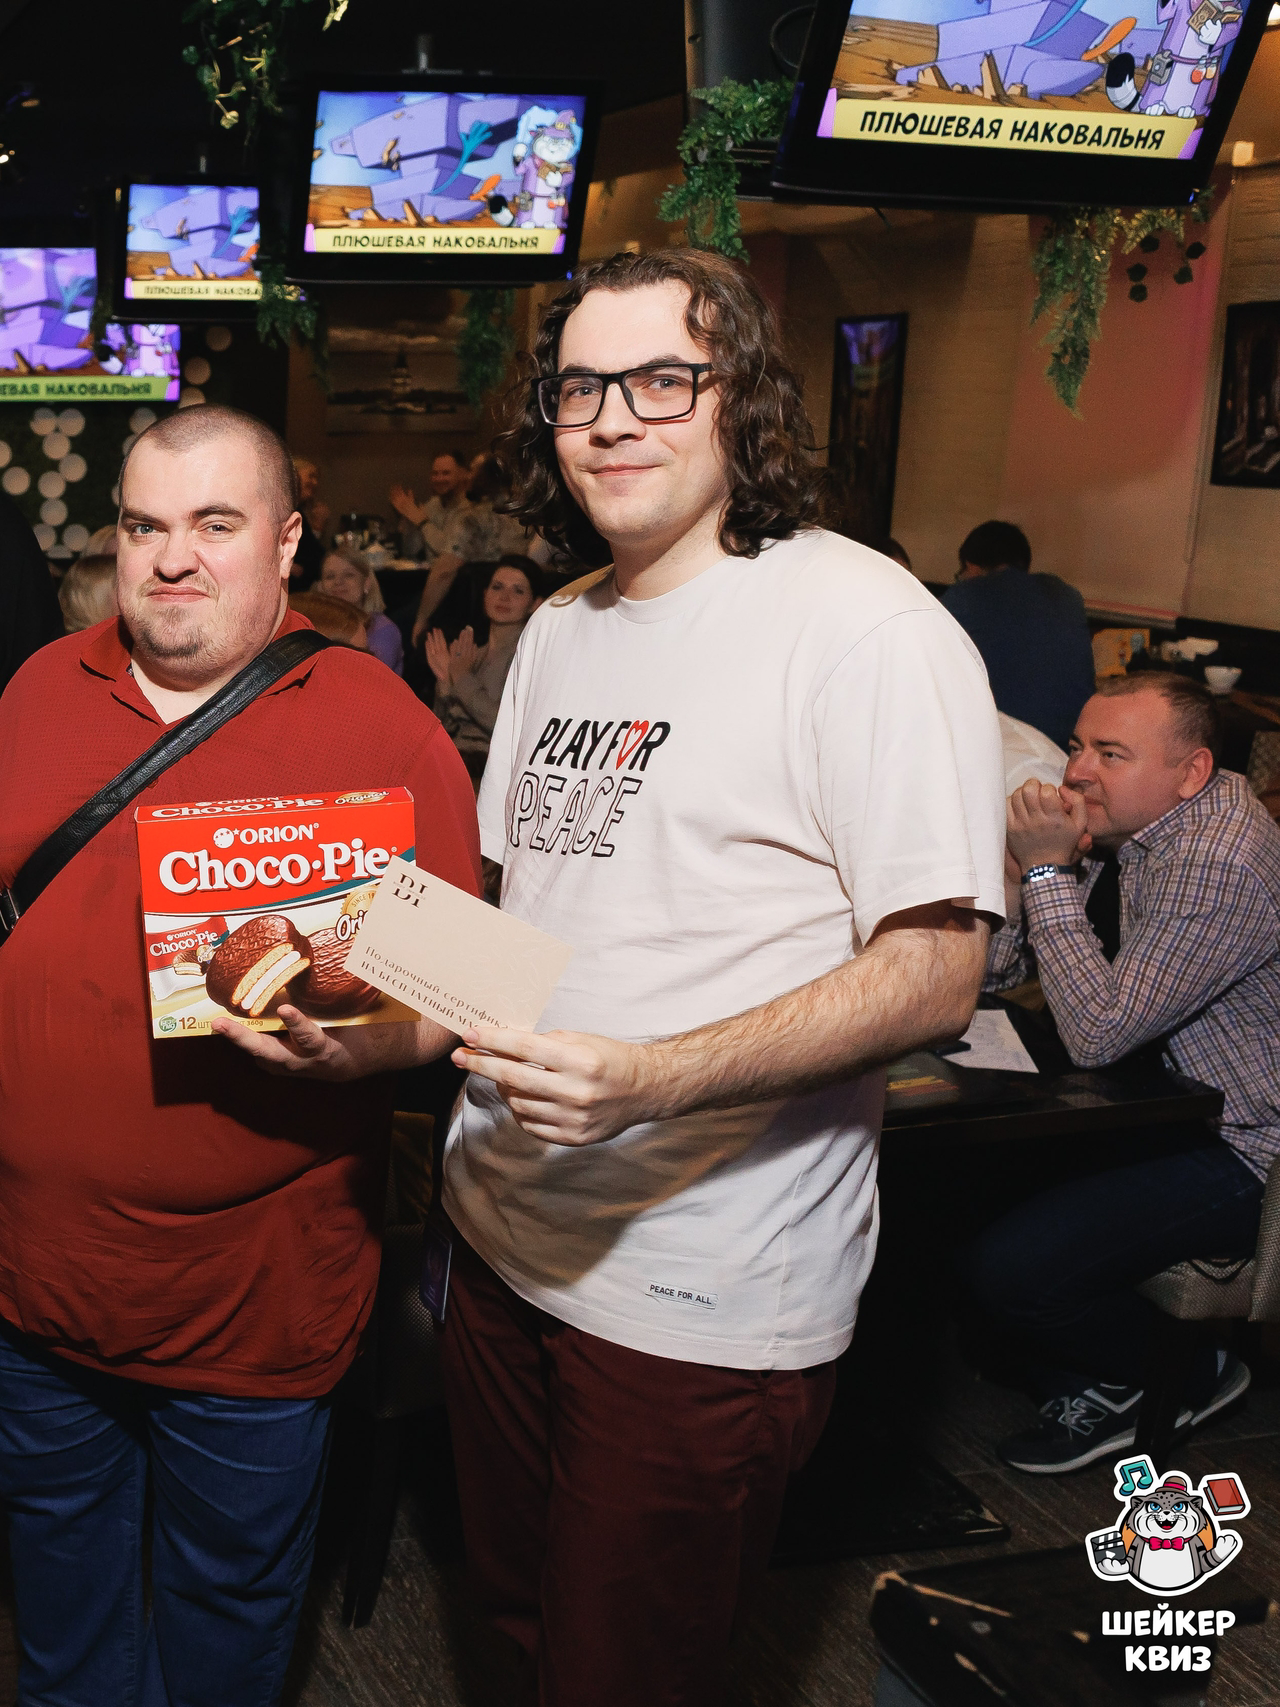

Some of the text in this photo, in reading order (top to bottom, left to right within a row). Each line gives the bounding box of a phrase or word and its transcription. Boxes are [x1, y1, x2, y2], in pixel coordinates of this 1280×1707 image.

[859, 110, 1166, 151] ПЛЮШЕВАЯ НАКОВАЛЬНЯ
[332, 235, 539, 249] ПЛЮШЕВАЯ НАКОВАЛЬНЯ
[45, 382, 152, 396] НАКОВАЛЬНЯ
[510, 771, 643, 857] PEACE
[336, 910, 368, 941] Ori
[365, 946, 508, 1030] Подарочный сертифик
[178, 1016, 197, 1030] 12
[649, 1284, 712, 1305] PEACE FOR ALL
